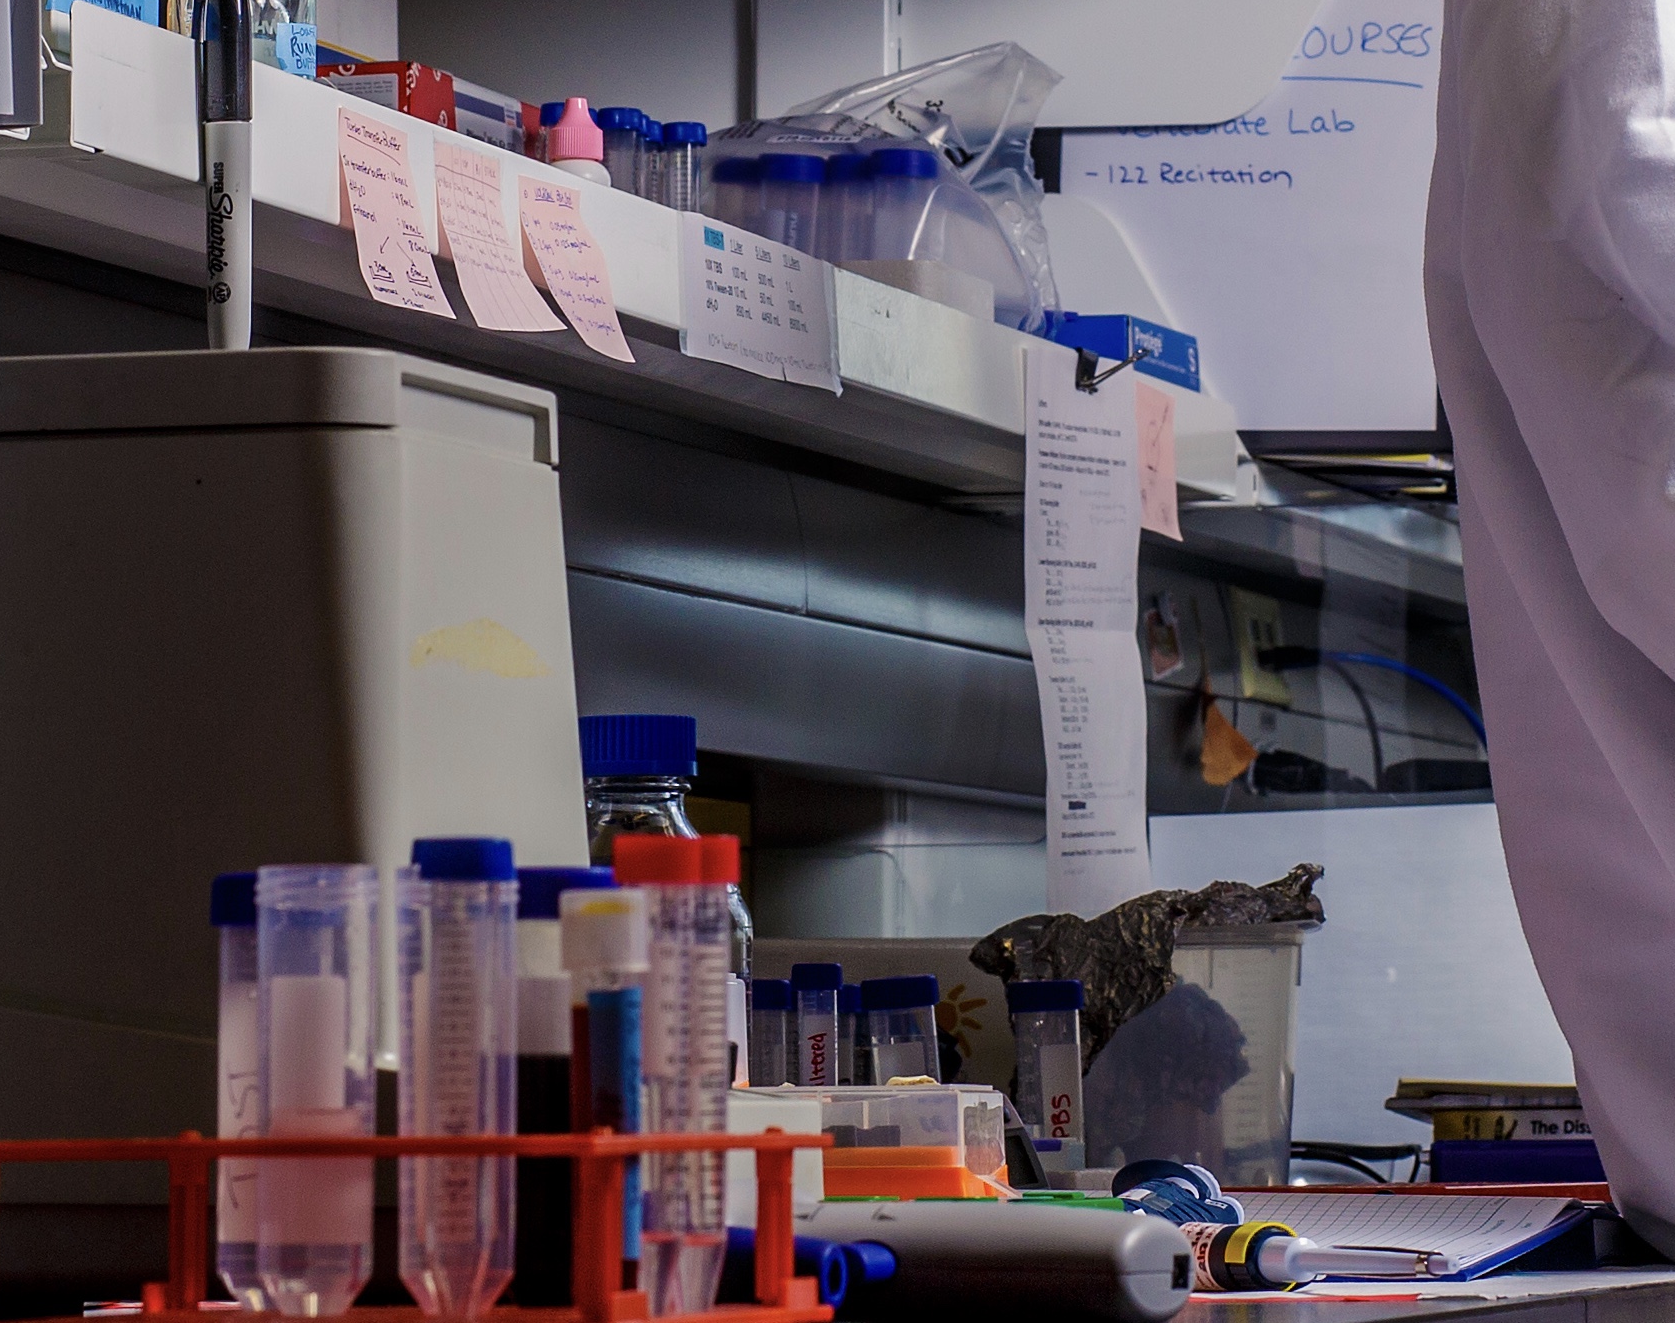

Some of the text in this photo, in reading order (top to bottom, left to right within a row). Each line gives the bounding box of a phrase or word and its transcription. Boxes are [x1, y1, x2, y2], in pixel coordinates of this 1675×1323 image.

[1292, 22, 1434, 59] OURSES
[1288, 108, 1356, 135] Lab
[213, 161, 224, 194] SUPER
[1160, 162, 1293, 189] Recitation
[209, 185, 233, 279] Sharpie
[807, 1032, 828, 1086] iltered
[1051, 1093, 1072, 1139] PBS
[1530, 1119, 1559, 1136] The
